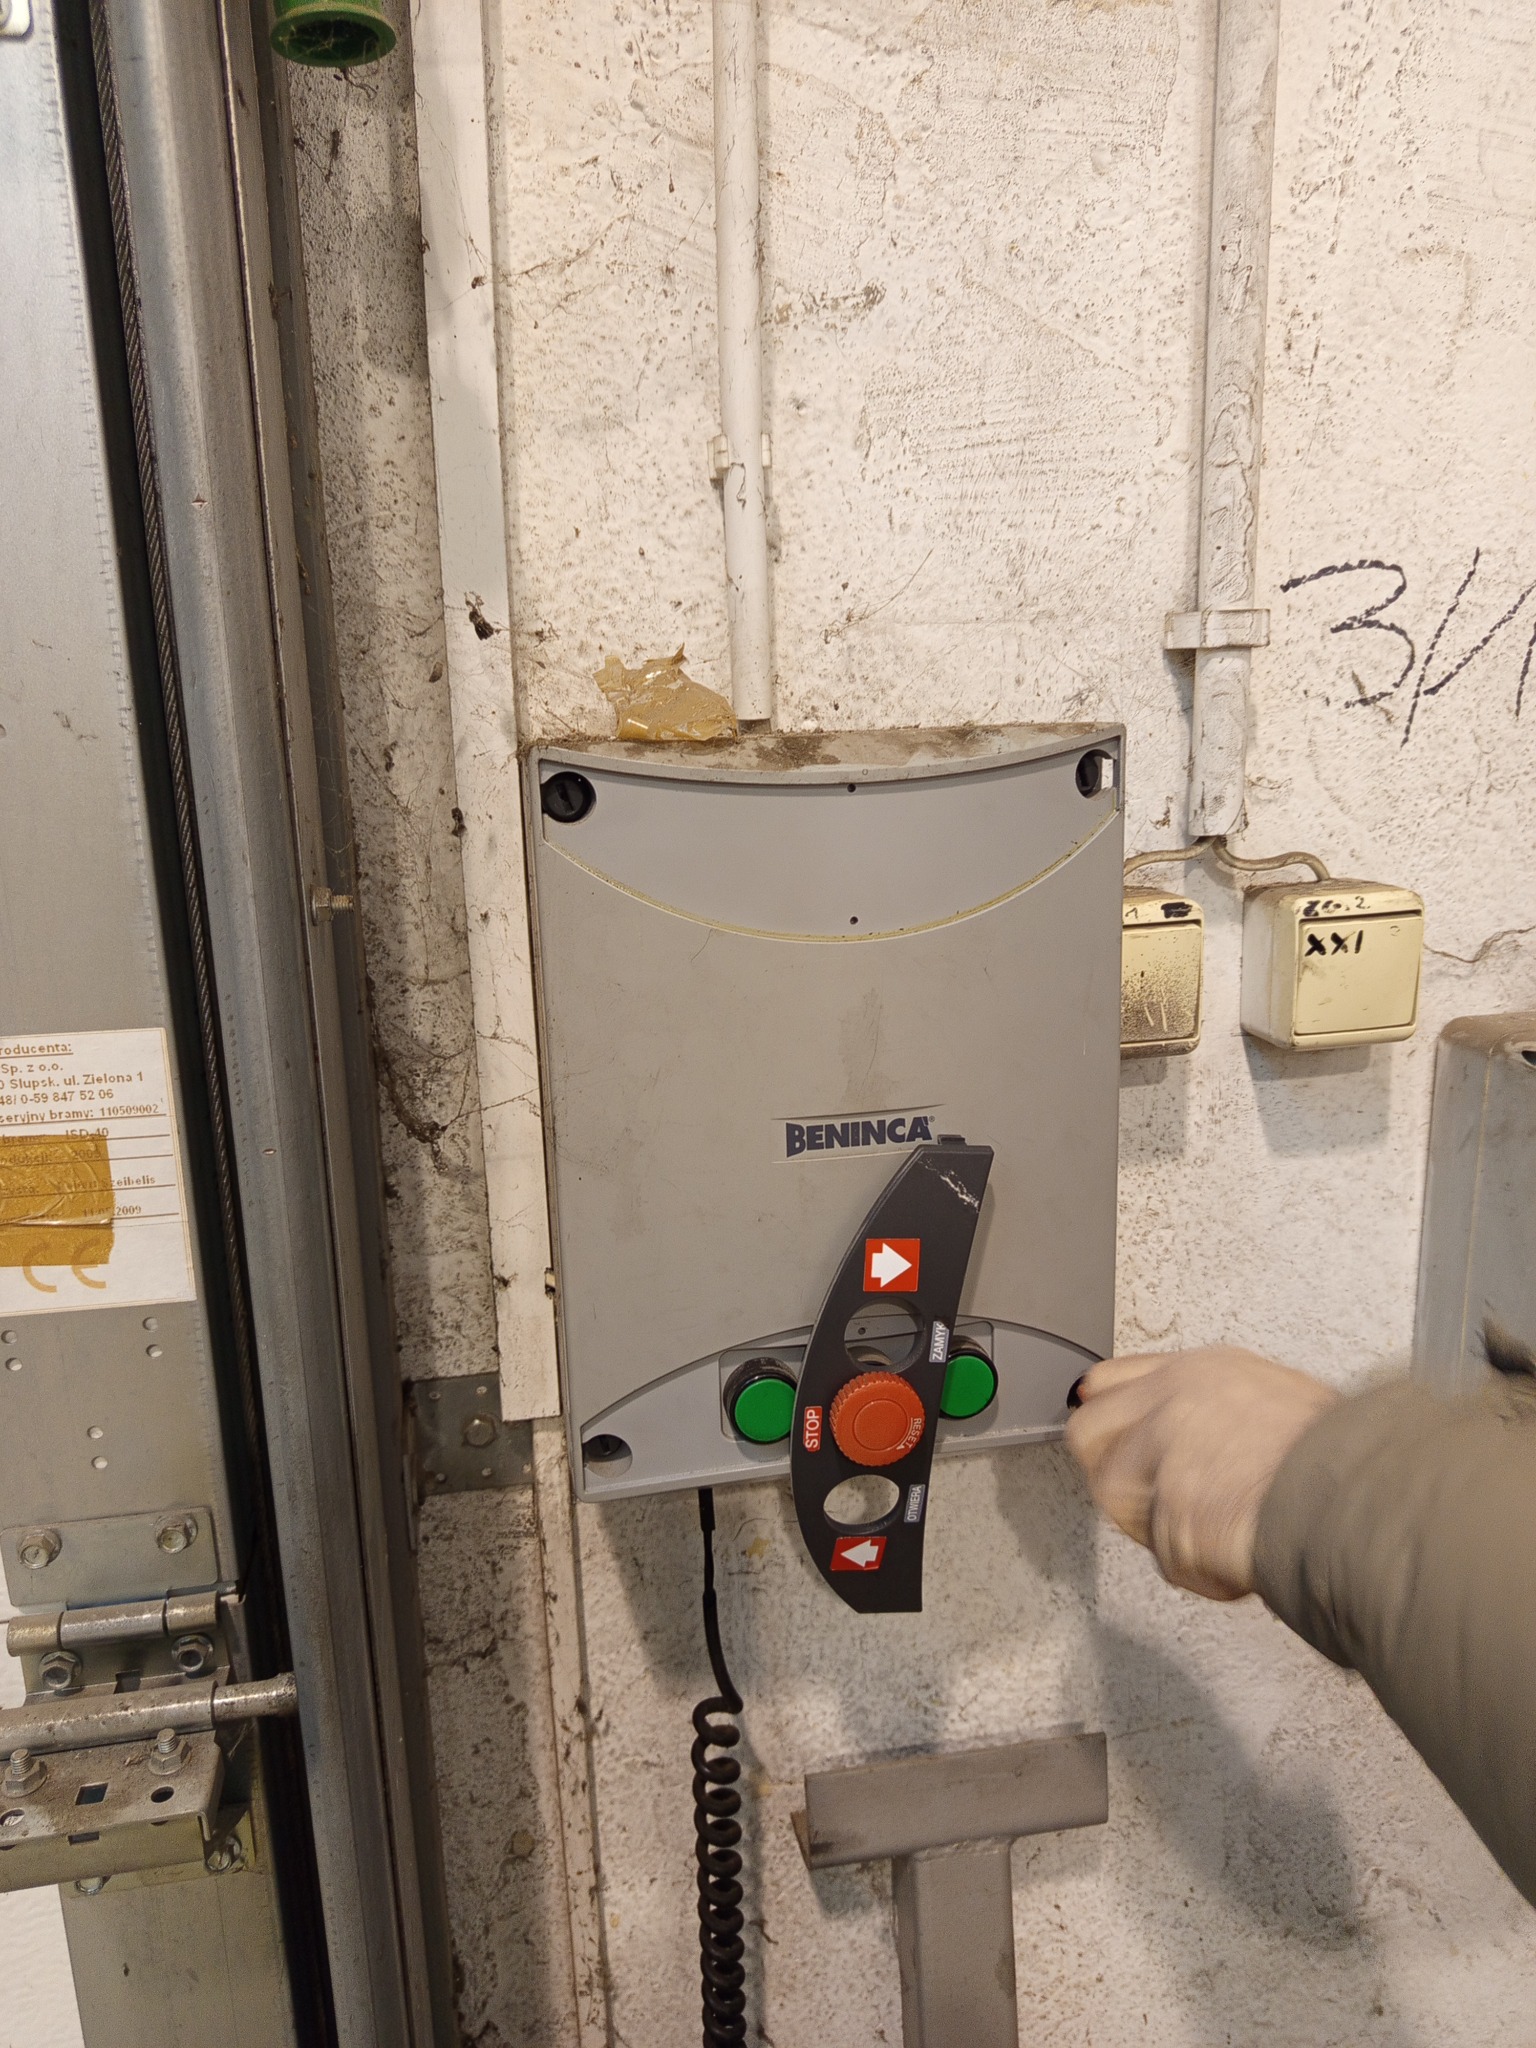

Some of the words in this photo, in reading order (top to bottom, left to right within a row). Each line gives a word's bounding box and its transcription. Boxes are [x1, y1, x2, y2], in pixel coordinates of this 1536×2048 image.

[1, 1063, 23, 1076] Sp.
[26, 1064, 35, 1073] z
[38, 1063, 64, 1072] o.o.
[63, 1075, 80, 1086] ul.
[82, 1073, 133, 1085] Zielona
[136, 1071, 144, 1082] 1
[20, 1092, 49, 1104] 0-59
[52, 1091, 75, 1103] 847
[80, 1090, 96, 1101] 52
[98, 1088, 114, 1100] 06
[49, 1109, 95, 1120] bramy:
[100, 1103, 160, 1117] 110509002
[804, 1409, 820, 1449] STOP
[905, 1417, 922, 1449] RESET
